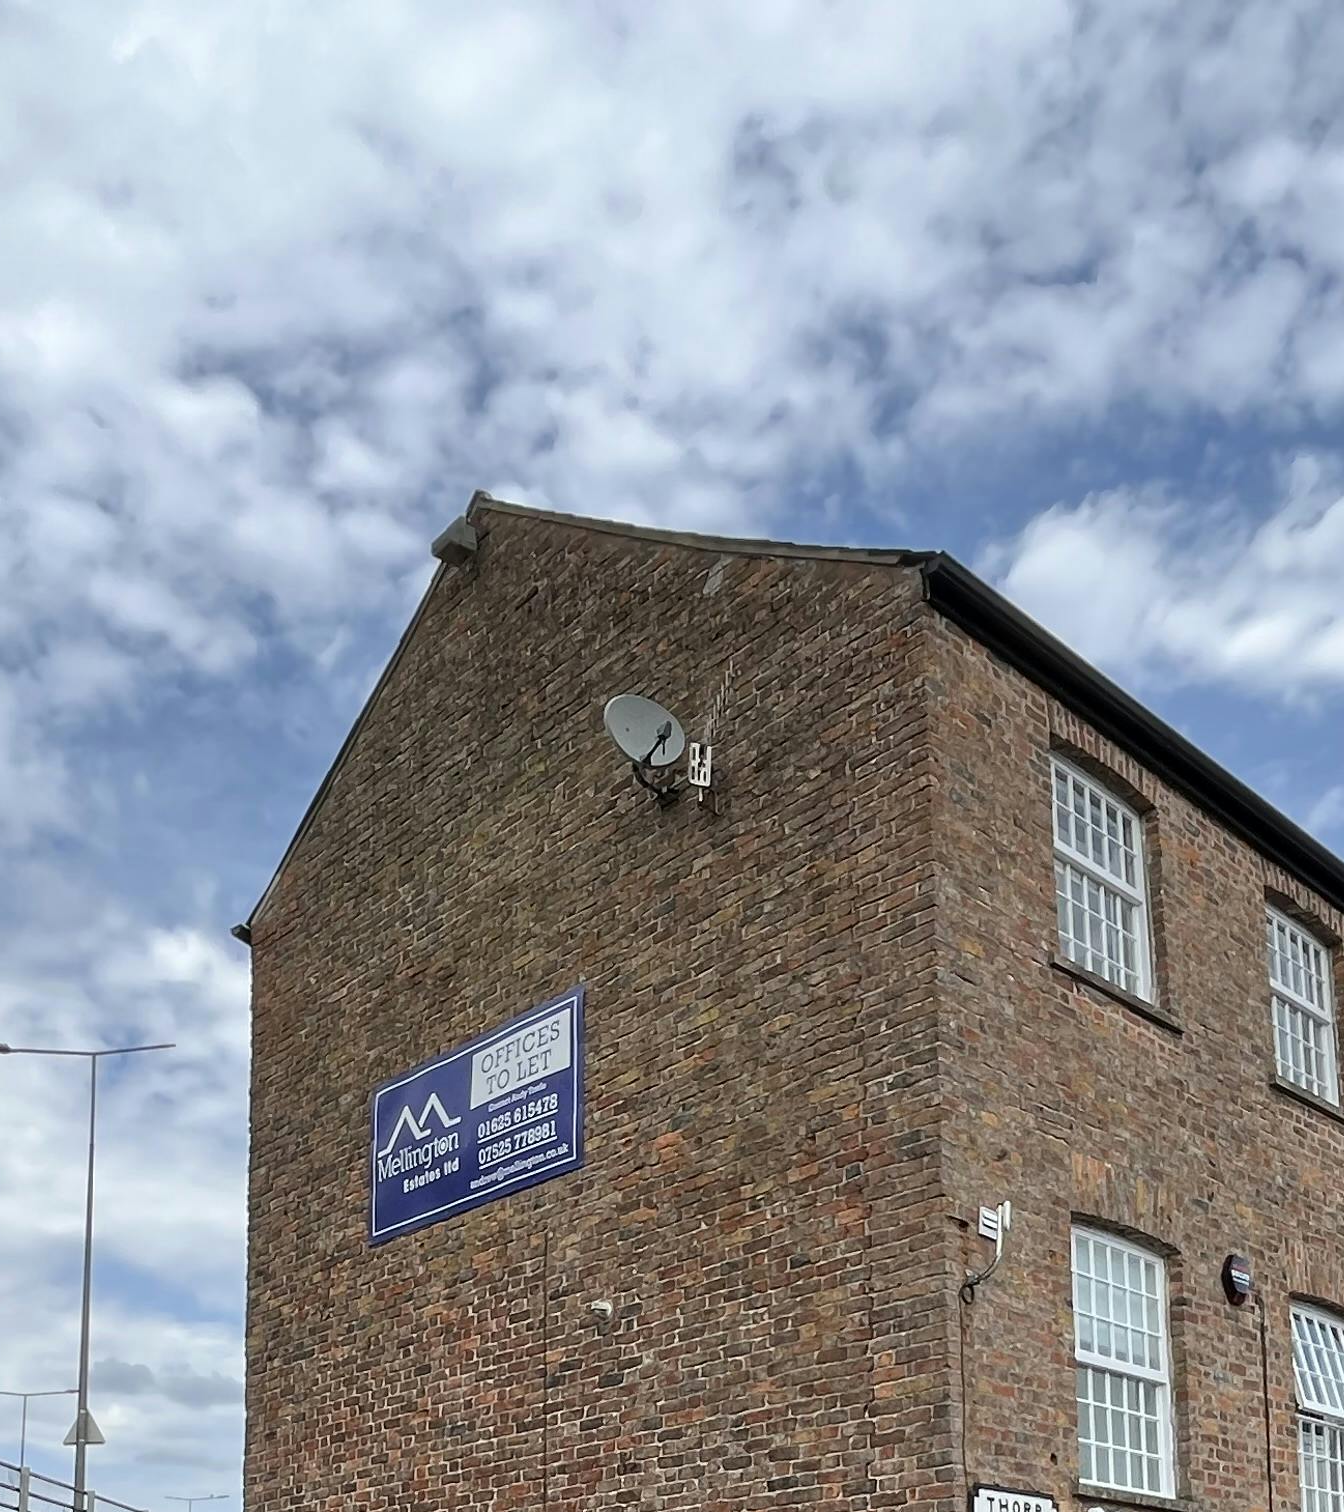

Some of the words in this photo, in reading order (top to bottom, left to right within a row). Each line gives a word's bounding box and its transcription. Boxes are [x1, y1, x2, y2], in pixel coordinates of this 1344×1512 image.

[481, 1020, 560, 1073] OFFICES
[486, 1068, 510, 1095] TO
[517, 1049, 552, 1081] LET
[477, 1111, 512, 1139] 01625
[514, 1093, 558, 1123] 615478
[377, 1132, 459, 1182] Mellington
[478, 1138, 512, 1164] 07525
[514, 1120, 556, 1149] 778981
[403, 1168, 441, 1193] Estates
